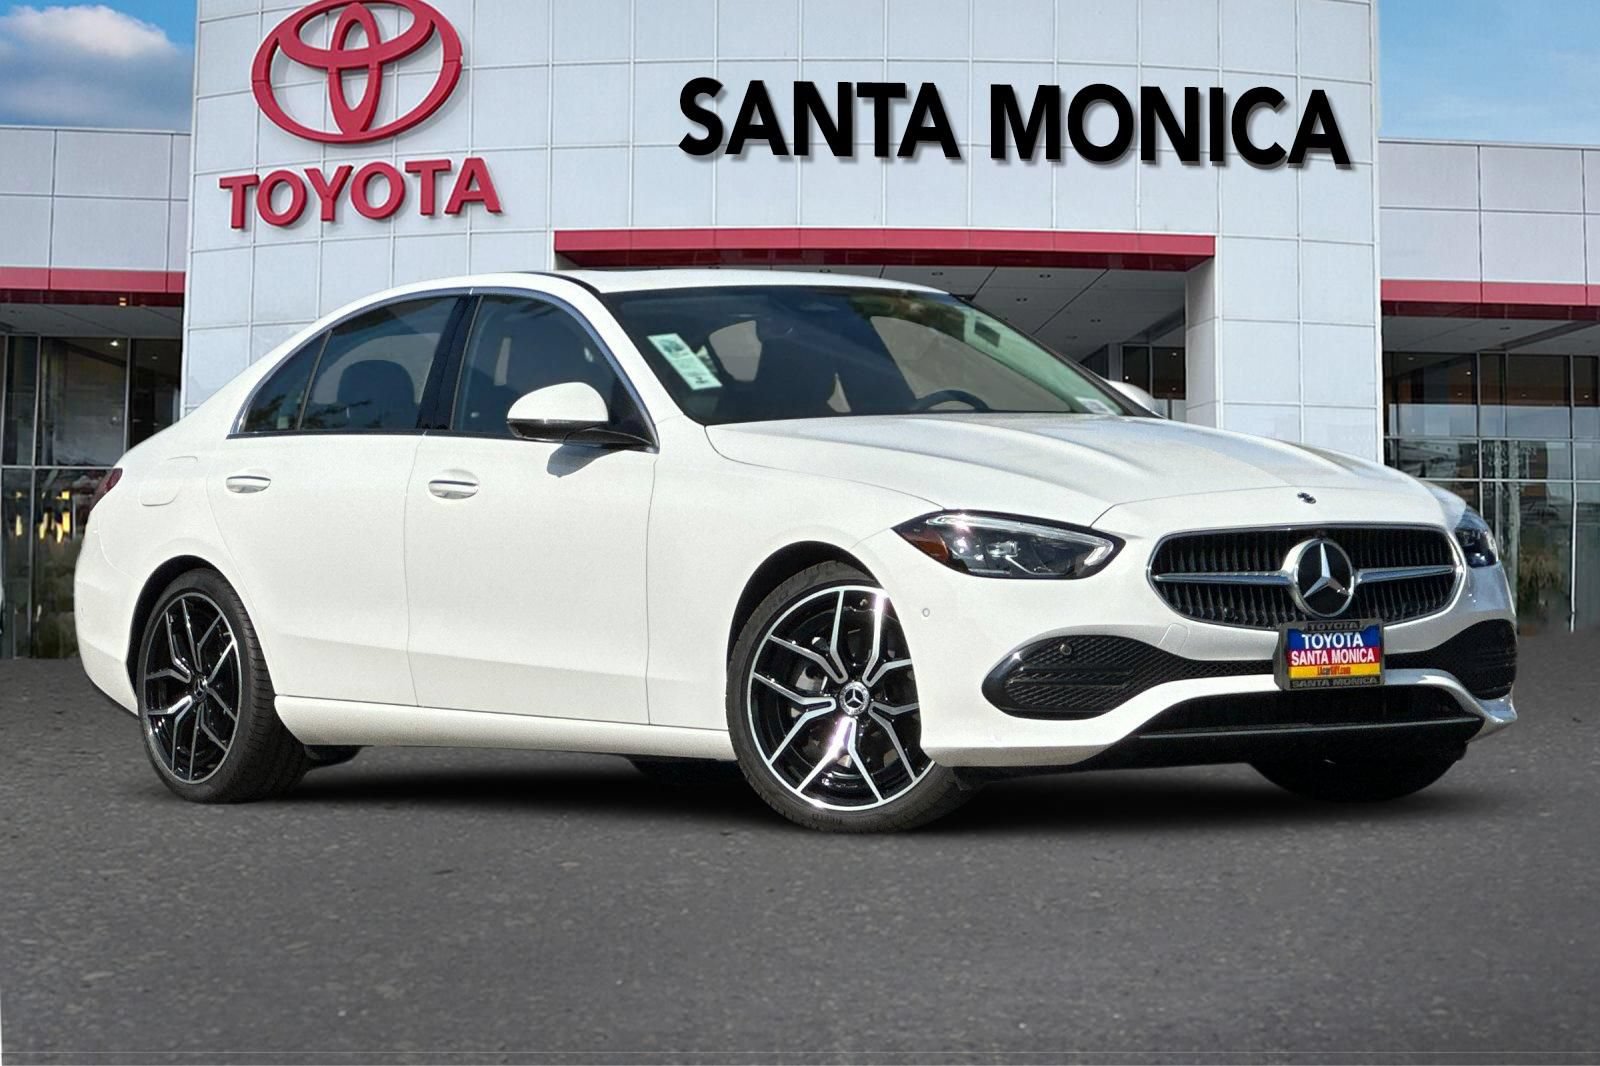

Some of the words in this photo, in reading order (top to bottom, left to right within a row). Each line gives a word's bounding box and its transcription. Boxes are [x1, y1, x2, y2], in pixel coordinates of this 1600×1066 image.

[678, 77, 962, 161] SANTA
[990, 83, 1352, 169] MONICA
[219, 157, 502, 229] TOYOTA
[1310, 622, 1358, 630] TOYOTA
[1301, 632, 1364, 649] TOYOTA
[1291, 650, 1329, 666] SANTA
[1331, 648, 1375, 664] MONICA
[1293, 680, 1330, 688] SANTA
[1333, 677, 1377, 686] MONICA
